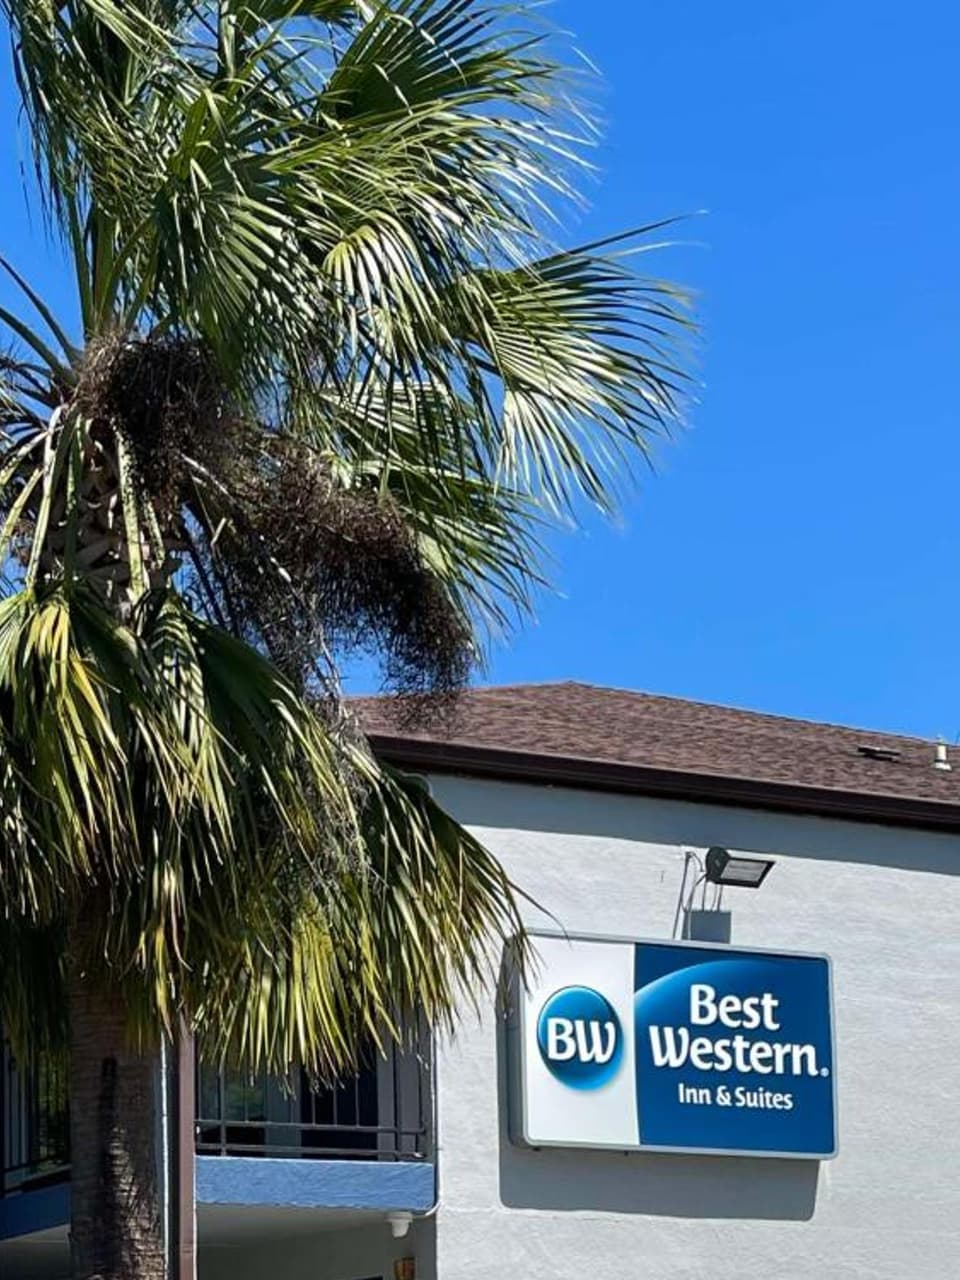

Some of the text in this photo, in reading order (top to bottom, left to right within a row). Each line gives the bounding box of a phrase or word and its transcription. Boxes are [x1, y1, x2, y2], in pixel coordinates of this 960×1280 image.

[690, 983, 780, 1031] Best
[547, 1016, 615, 1064] BW
[678, 1083, 793, 1110] Inn & Suites
